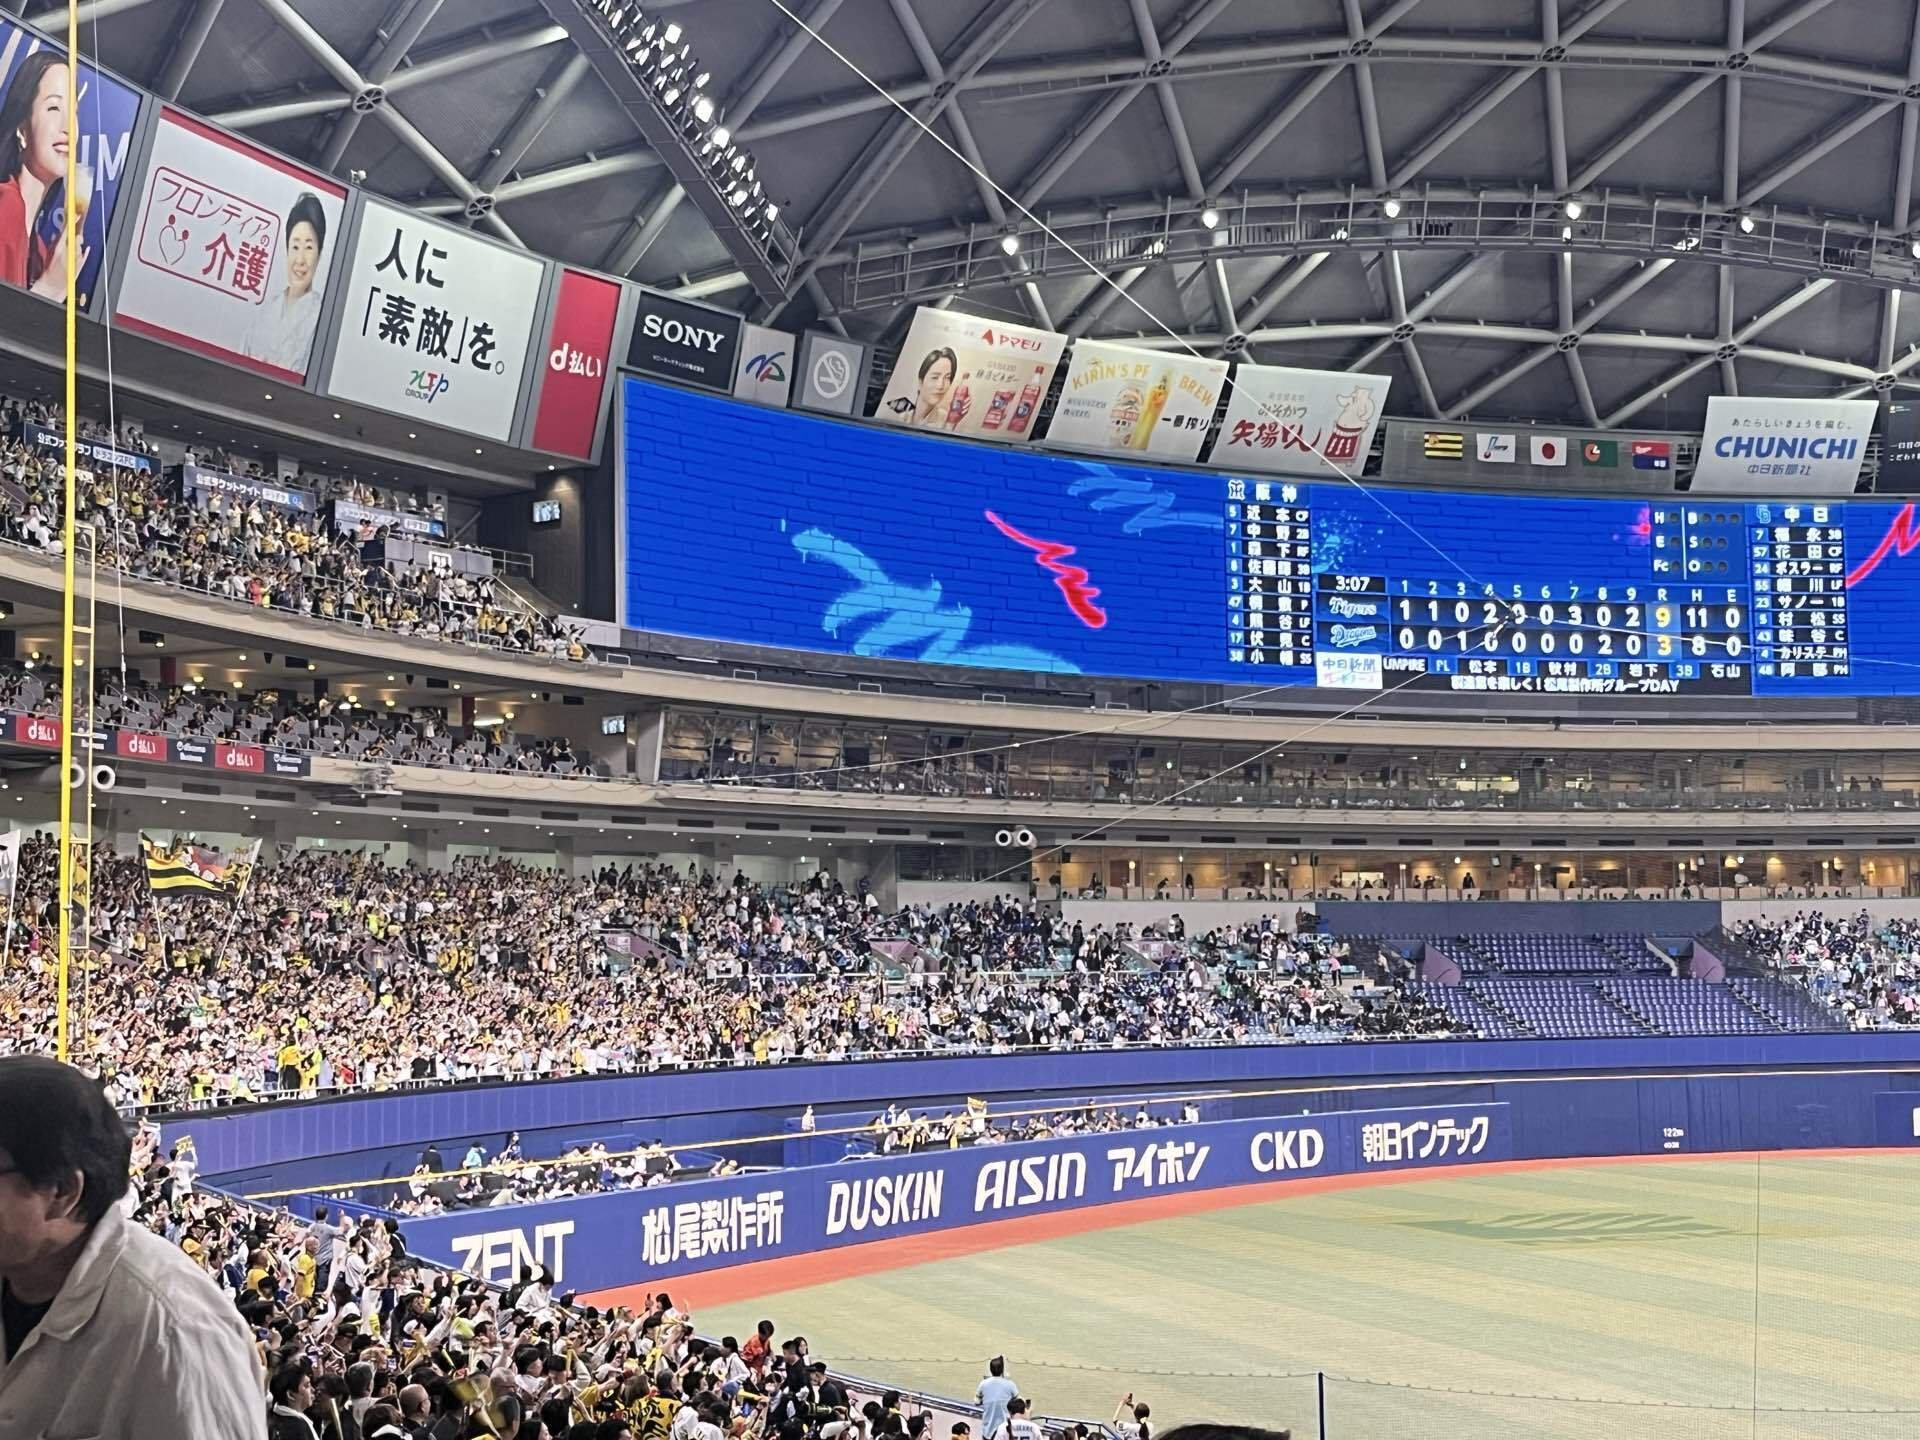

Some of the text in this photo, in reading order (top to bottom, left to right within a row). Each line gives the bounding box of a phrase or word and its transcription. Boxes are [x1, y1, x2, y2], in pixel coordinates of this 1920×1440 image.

[202, 232, 268, 296] 介護
[375, 228, 447, 288] 人に
[362, 286, 504, 375] 「素敵」を。
[643, 314, 725, 352] SONY
[1000, 334, 1042, 351] ヤマモリ
[551, 343, 601, 377] d払い
[1072, 363, 1129, 390] KIRIN'S
[1179, 375, 1215, 407] BREW
[405, 388, 429, 400] GROUP
[1162, 415, 1209, 431] 一番搾り
[1715, 436, 1857, 459] CHUNICHI
[1747, 464, 1811, 476] 中日新聞社
[1654, 511, 1665, 524] H
[1784, 505, 1828, 523] 中日
[1229, 523, 1237, 535] 7
[1756, 530, 1763, 540] 7
[1231, 541, 1236, 553] 1
[1655, 535, 1698, 548] E S
[1753, 546, 1767, 558] 57
[1775, 544, 1822, 559] 花田
[1653, 559, 1701, 573] Fc O
[1249, 577, 1291, 594] 大山
[1336, 576, 1370, 591] 3:07
[1402, 580, 1408, 593] 1
[1429, 581, 1438, 595] 2
[1457, 582, 1466, 595] 3
[1513, 585, 1522, 598] 5
[1541, 586, 1551, 598] 6
[1569, 587, 1579, 599] 7
[1598, 587, 1607, 600] 8
[1627, 588, 1636, 600] 9
[1658, 588, 1667, 601] R
[1692, 589, 1702, 601] H
[1727, 589, 1736, 602] E
[1831, 580, 1843, 590] LF
[1301, 600, 1308, 610] P
[1778, 595, 1824, 609] サノー
[1329, 597, 1377, 618] Tigers
[1400, 600, 1410, 620] 1
[1429, 601, 1438, 621] 1
[1455, 602, 1470, 622] 0
[1483, 603, 1498, 623] 2
[1539, 605, 1554, 625] 0
[1568, 606, 1582, 625] 3
[1596, 606, 1611, 626] 0
[1625, 607, 1640, 627] 2
[1656, 608, 1671, 628] 9
[1687, 608, 1707, 628] 11
[1725, 608, 1740, 628] 0
[1778, 612, 1826, 627] 村松
[1832, 613, 1845, 624] SS
[1231, 632, 1242, 644] 17
[1301, 635, 1310, 646] C
[1330, 624, 1377, 647] Dragons
[1400, 628, 1414, 649] 0
[1428, 629, 1442, 650] 0
[1457, 631, 1467, 651] 1
[1512, 632, 1526, 653] 0
[1540, 633, 1555, 653] 0
[1569, 633, 1583, 654] 0
[1598, 634, 1613, 654] 2
[1626, 635, 1640, 655] 0
[1657, 635, 1671, 655] 3
[1692, 636, 1706, 656] 8
[1727, 636, 1741, 656] 0
[1835, 630, 1844, 641] C
[1300, 652, 1312, 664] SS
[1780, 646, 1827, 659] カリステ
[1323, 657, 1376, 672] 中日新聞
[1383, 658, 1426, 671] UMPIRE
[1469, 660, 1497, 673] 松本
[1516, 662, 1530, 673] 1B
[1595, 664, 1611, 675] 2B
[1629, 664, 1658, 676] 岩下
[1676, 665, 1692, 676] 3B
[1711, 664, 1741, 678] 石山
[1362, 1116, 1488, 1163] 朝日インテック
[1250, 1128, 1324, 1173] CKD
[1107, 1141, 1211, 1191] アイホン
[974, 1152, 1087, 1212] AISIN
[642, 1190, 784, 1266] 松尾製作所
[451, 1220, 575, 1284] ZENT
